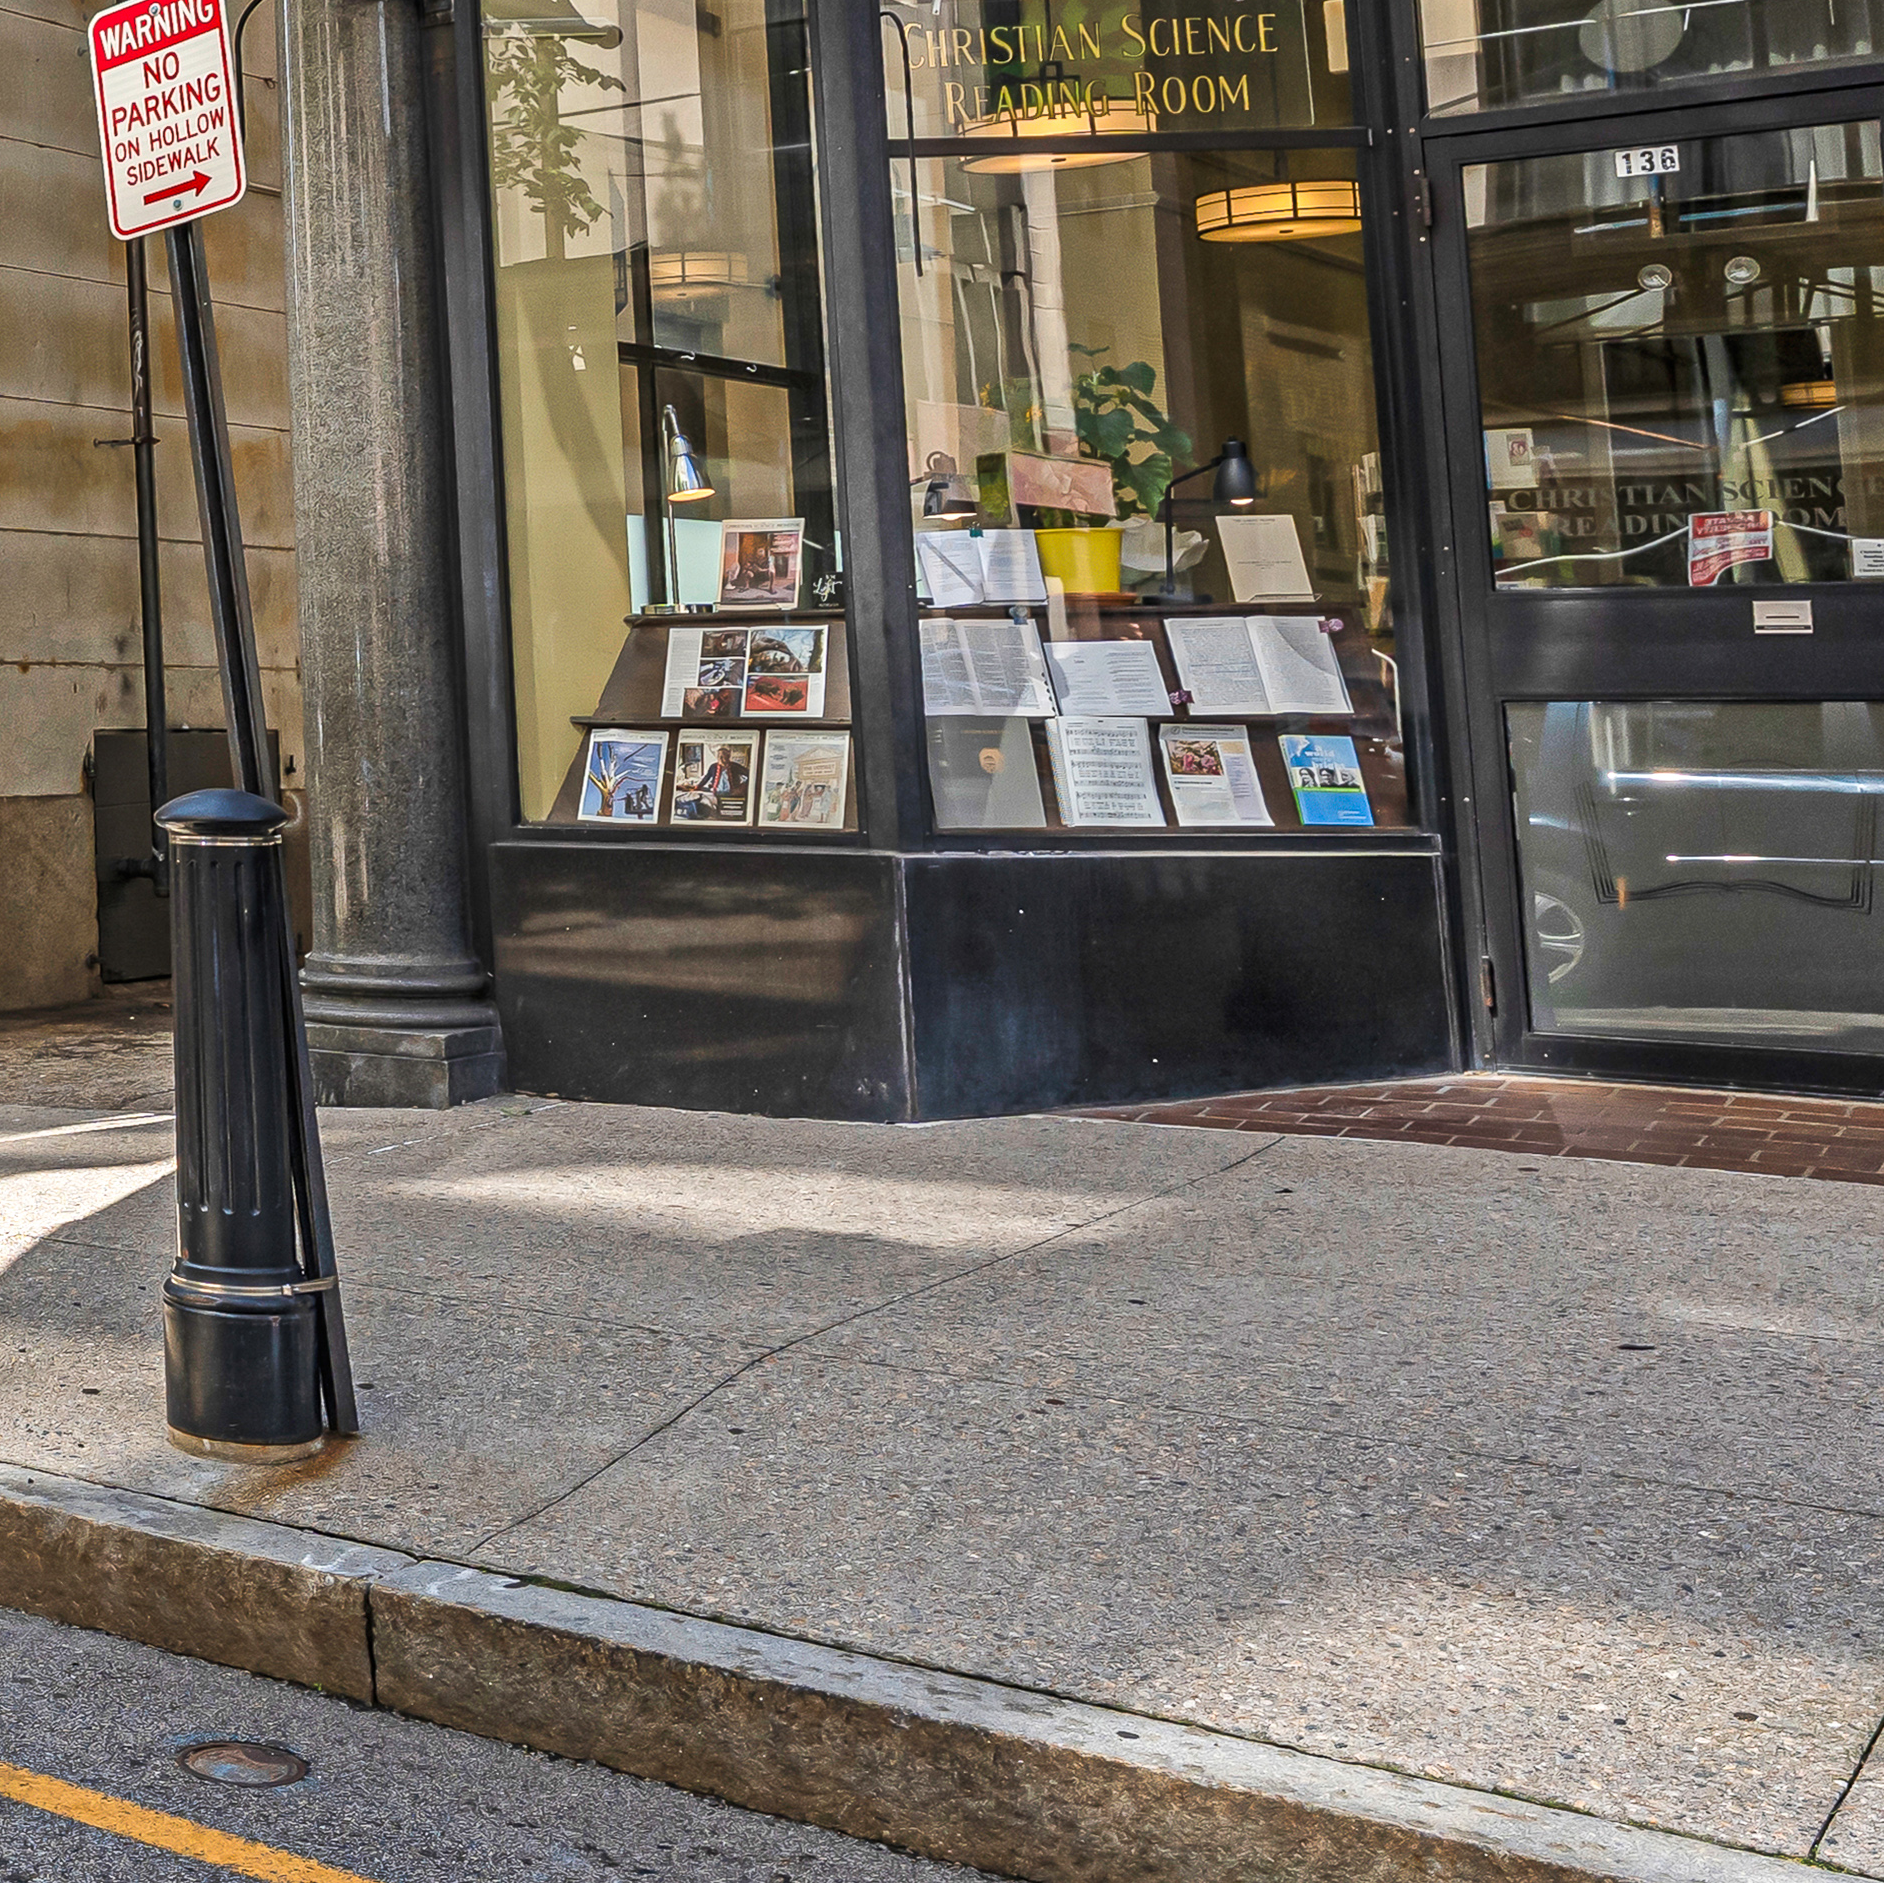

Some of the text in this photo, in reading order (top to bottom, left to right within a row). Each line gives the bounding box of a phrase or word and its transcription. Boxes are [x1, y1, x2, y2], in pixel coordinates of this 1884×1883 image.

[142, 51, 181, 89] NO
[904, 13, 1279, 71] CHRISTIAN SCIENCE
[111, 72, 221, 137] PARKING
[944, 70, 1252, 126] READING ROOM
[114, 106, 225, 163] ON HOLLOW
[126, 136, 221, 187] SIDEWALK
[1621, 147, 1677, 173] 136
